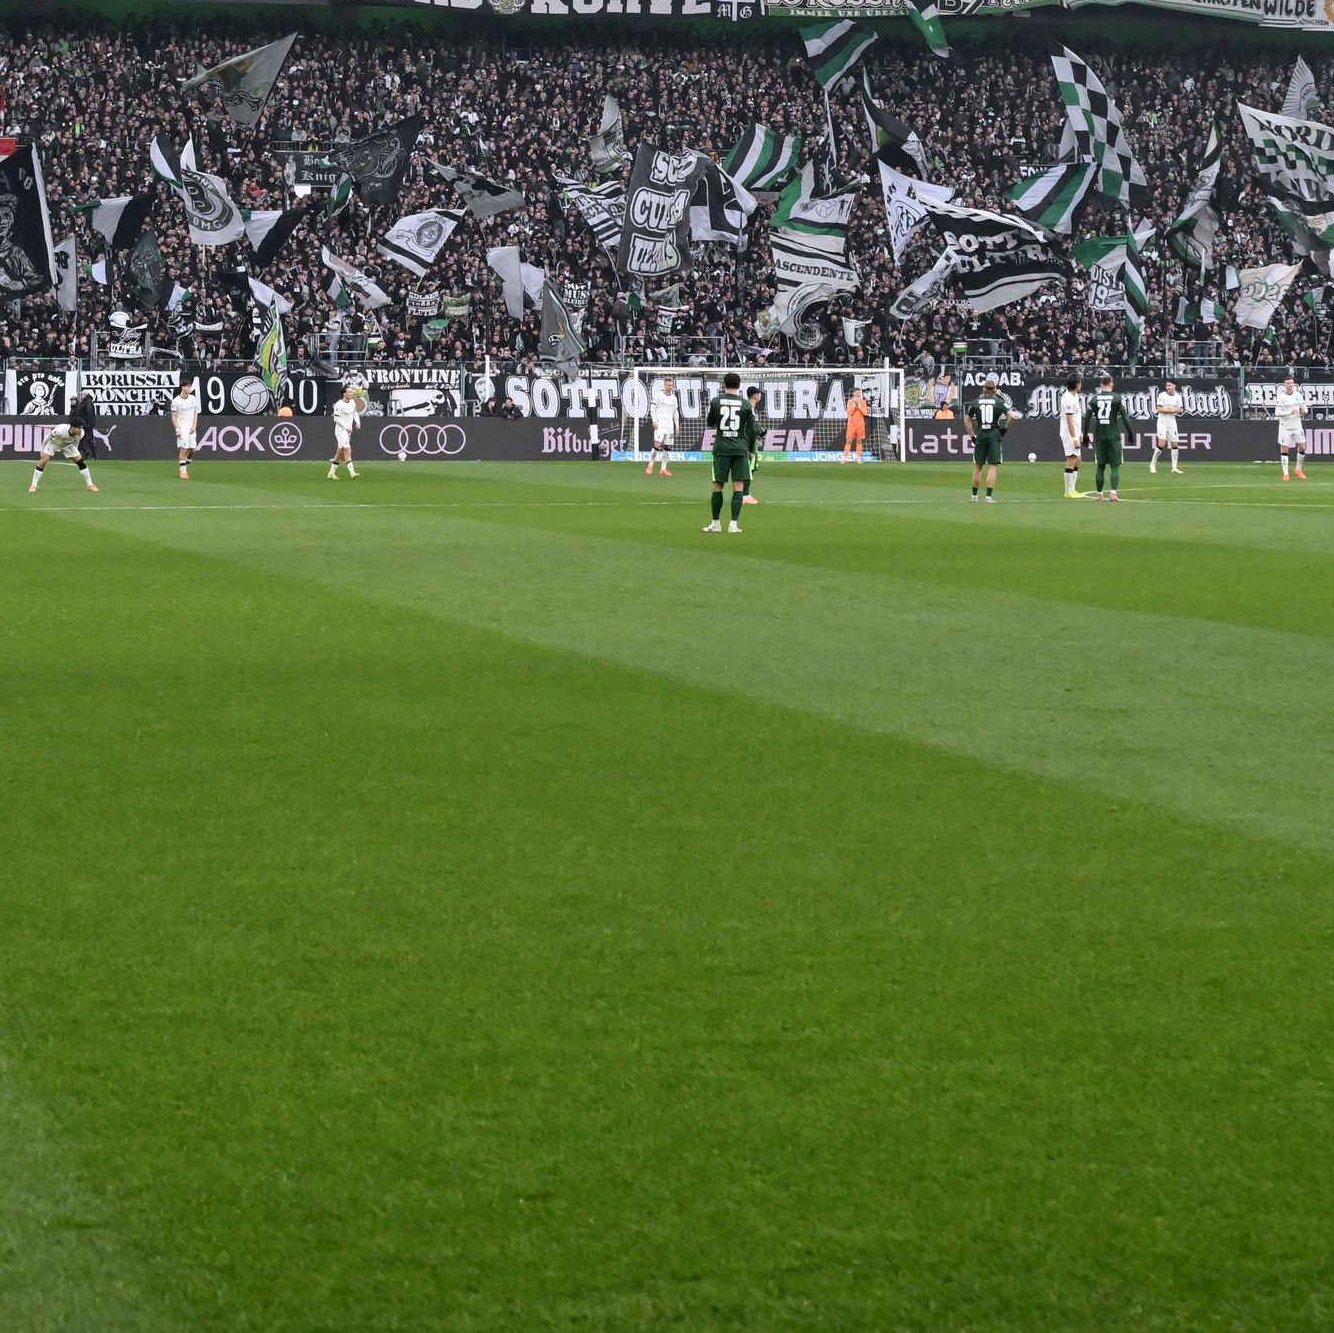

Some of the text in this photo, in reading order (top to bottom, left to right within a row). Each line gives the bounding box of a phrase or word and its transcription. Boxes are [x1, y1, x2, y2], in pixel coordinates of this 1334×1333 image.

[776, 258, 854, 282] ASCENDENTE
[86, 374, 175, 386] BORUSSIA
[367, 369, 460, 384] FRONTLINE
[90, 385, 174, 402] MÖNCHEN
[720, 406, 740, 430] 25
[980, 405, 993, 423] 10
[1098, 401, 1111, 419] 27
[196, 426, 266, 452] AOK
